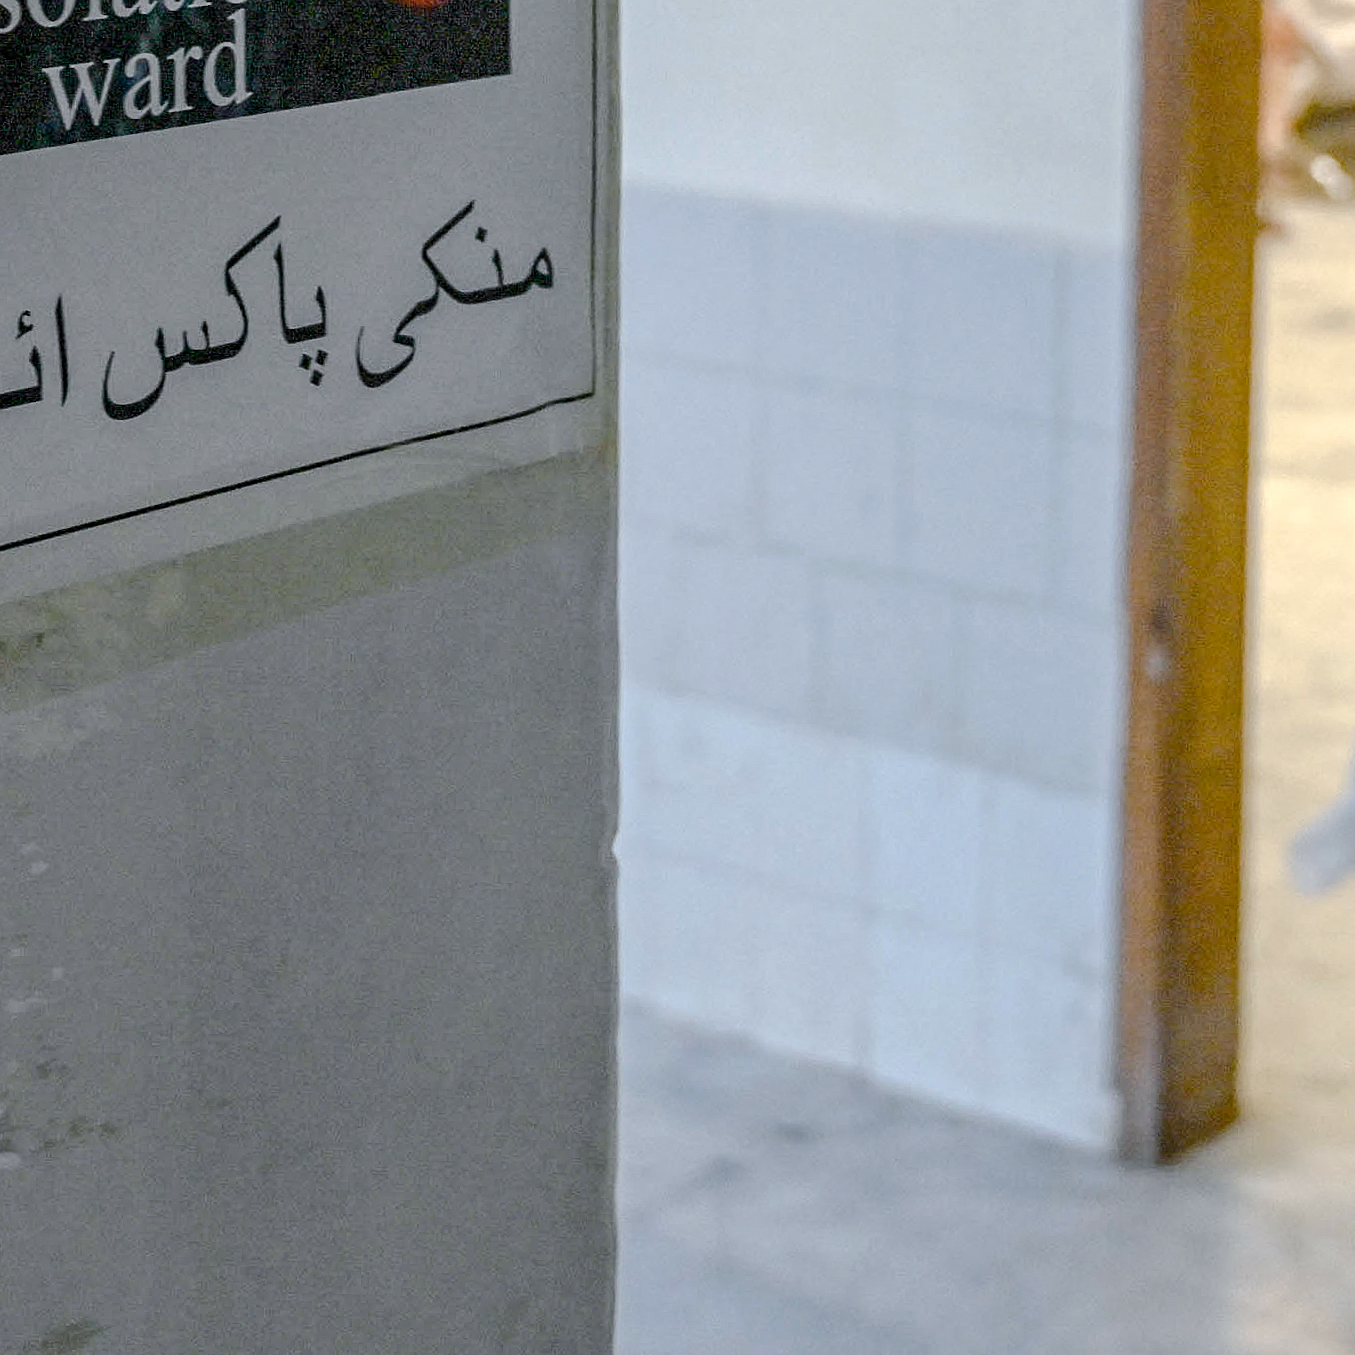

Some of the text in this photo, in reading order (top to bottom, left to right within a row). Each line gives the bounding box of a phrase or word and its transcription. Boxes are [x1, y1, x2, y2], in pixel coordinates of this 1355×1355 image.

[41, 7, 254, 131] ward
[101, 216, 328, 421] پاکس
[355, 200, 553, 388] منکی
